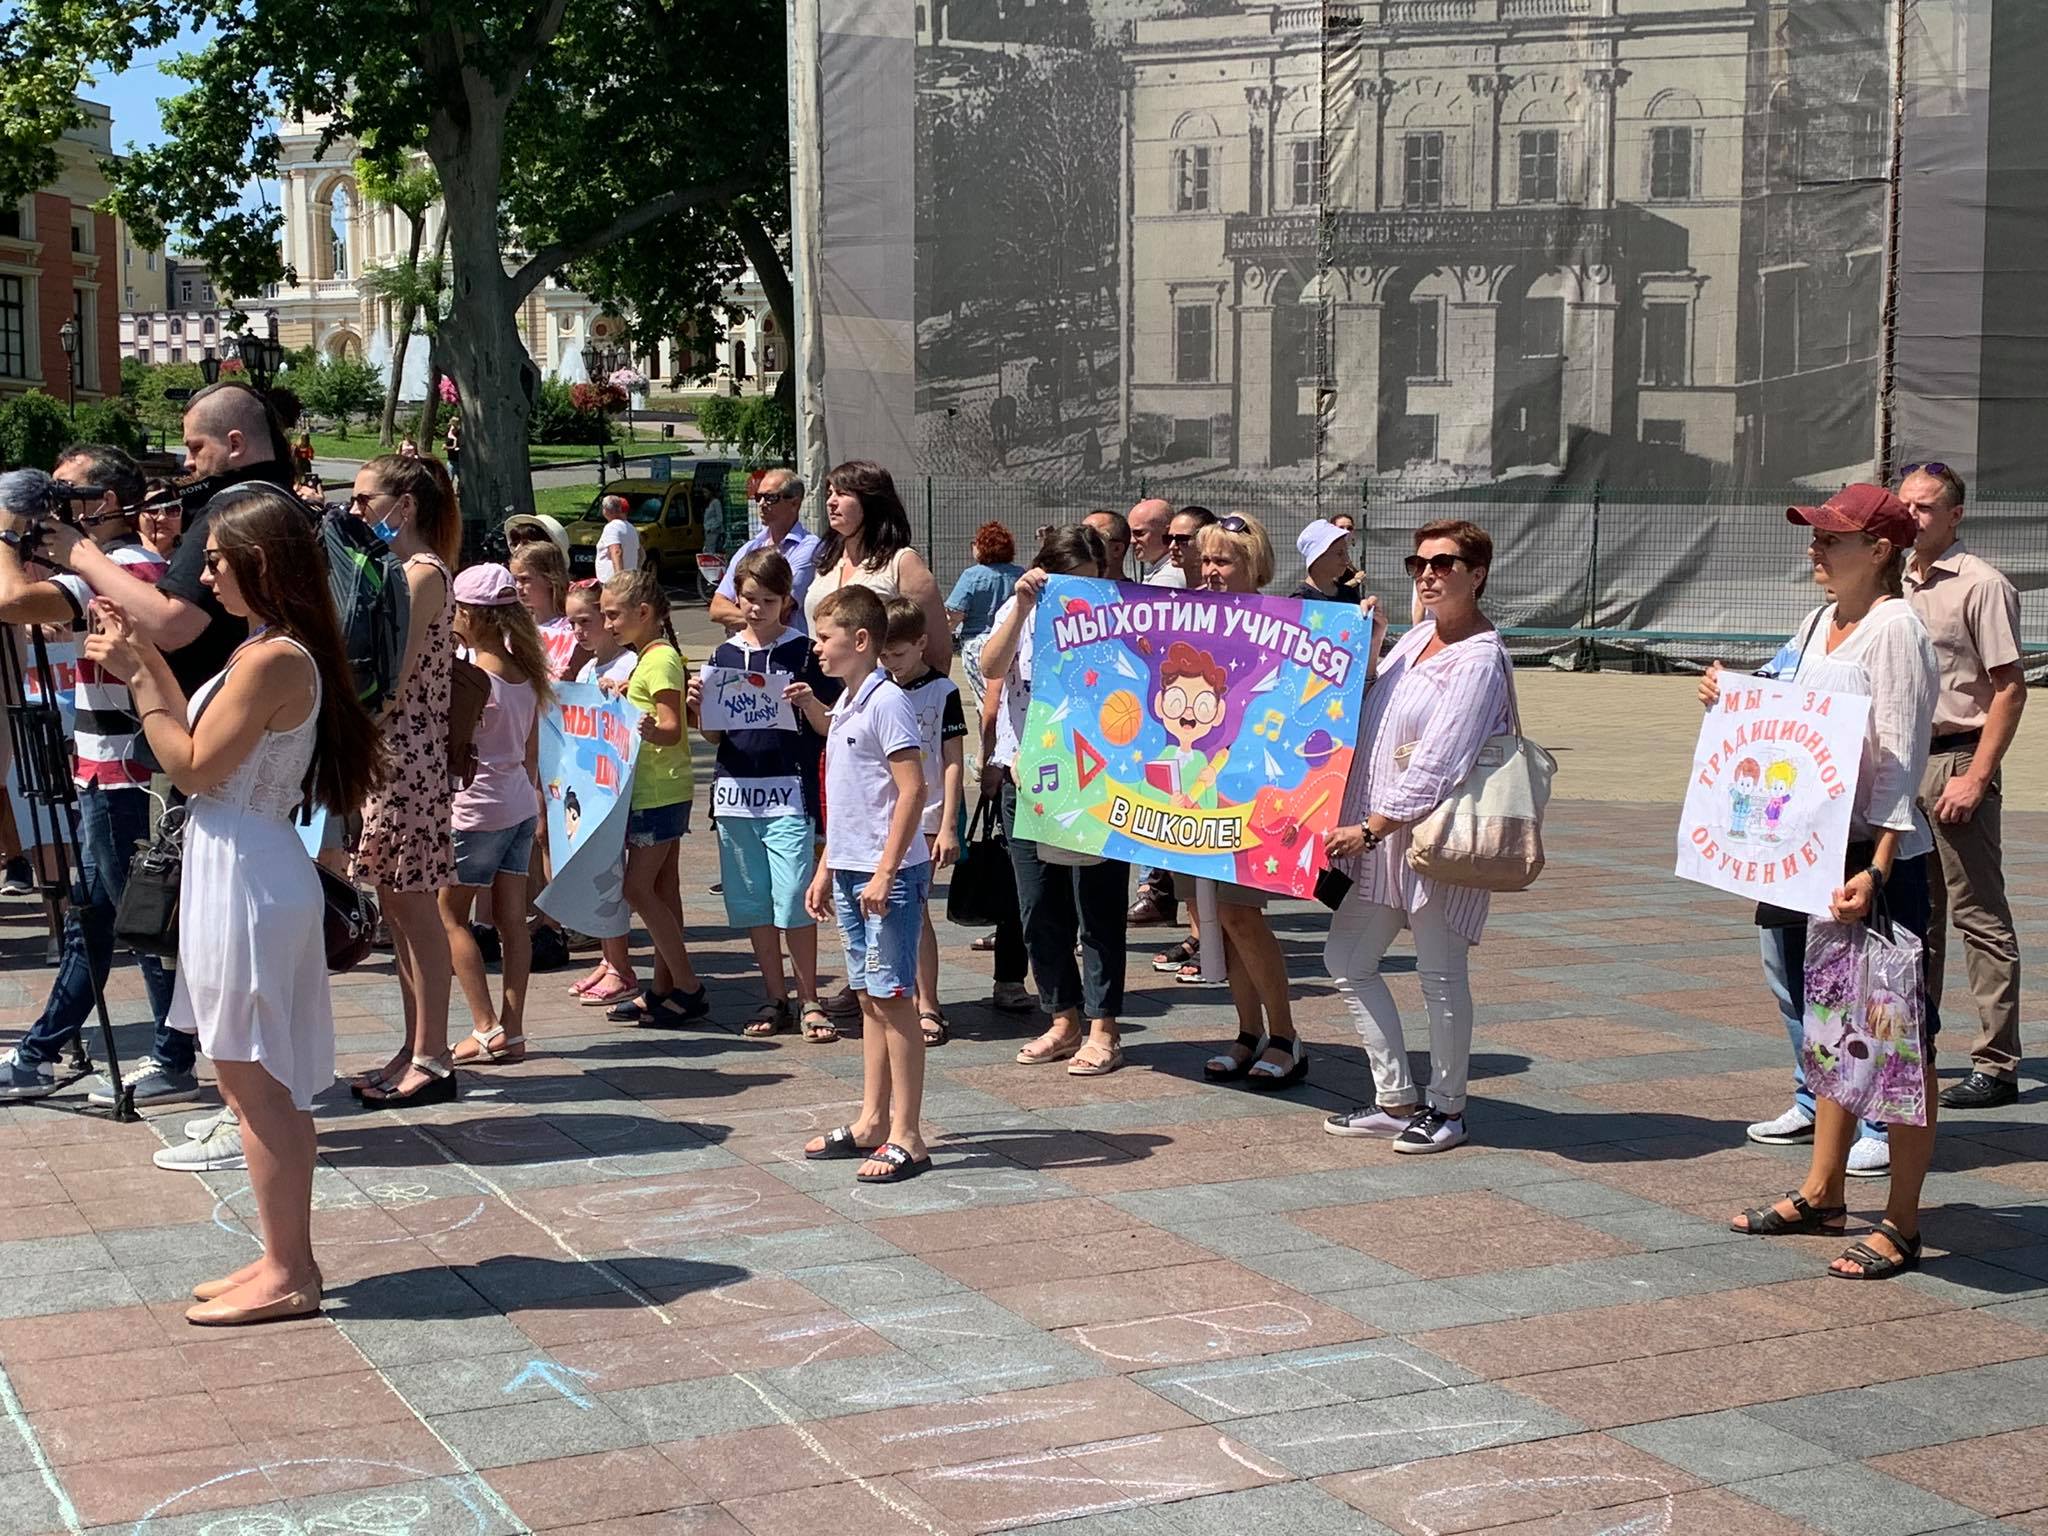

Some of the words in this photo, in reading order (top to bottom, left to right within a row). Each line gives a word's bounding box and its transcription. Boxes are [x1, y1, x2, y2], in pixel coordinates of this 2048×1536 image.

[179, 481, 209, 495] SONY
[1055, 609, 1106, 650] МЫ
[1112, 602, 1216, 637] ХОТИМ
[1224, 604, 1350, 685] УЧИТЬСЯ
[561, 704, 596, 737] МЫ
[1724, 688, 1762, 713] МЫ
[1802, 692, 1832, 716] ЗА
[1699, 719, 1846, 800] ТРАДИЦИОННОЕ
[717, 787, 792, 807] SUNDAY
[1109, 797, 1130, 827] В
[1131, 805, 1242, 848] ШКОЛЕ!
[1691, 826, 1825, 884] ОБУЧЕНИЕ!
